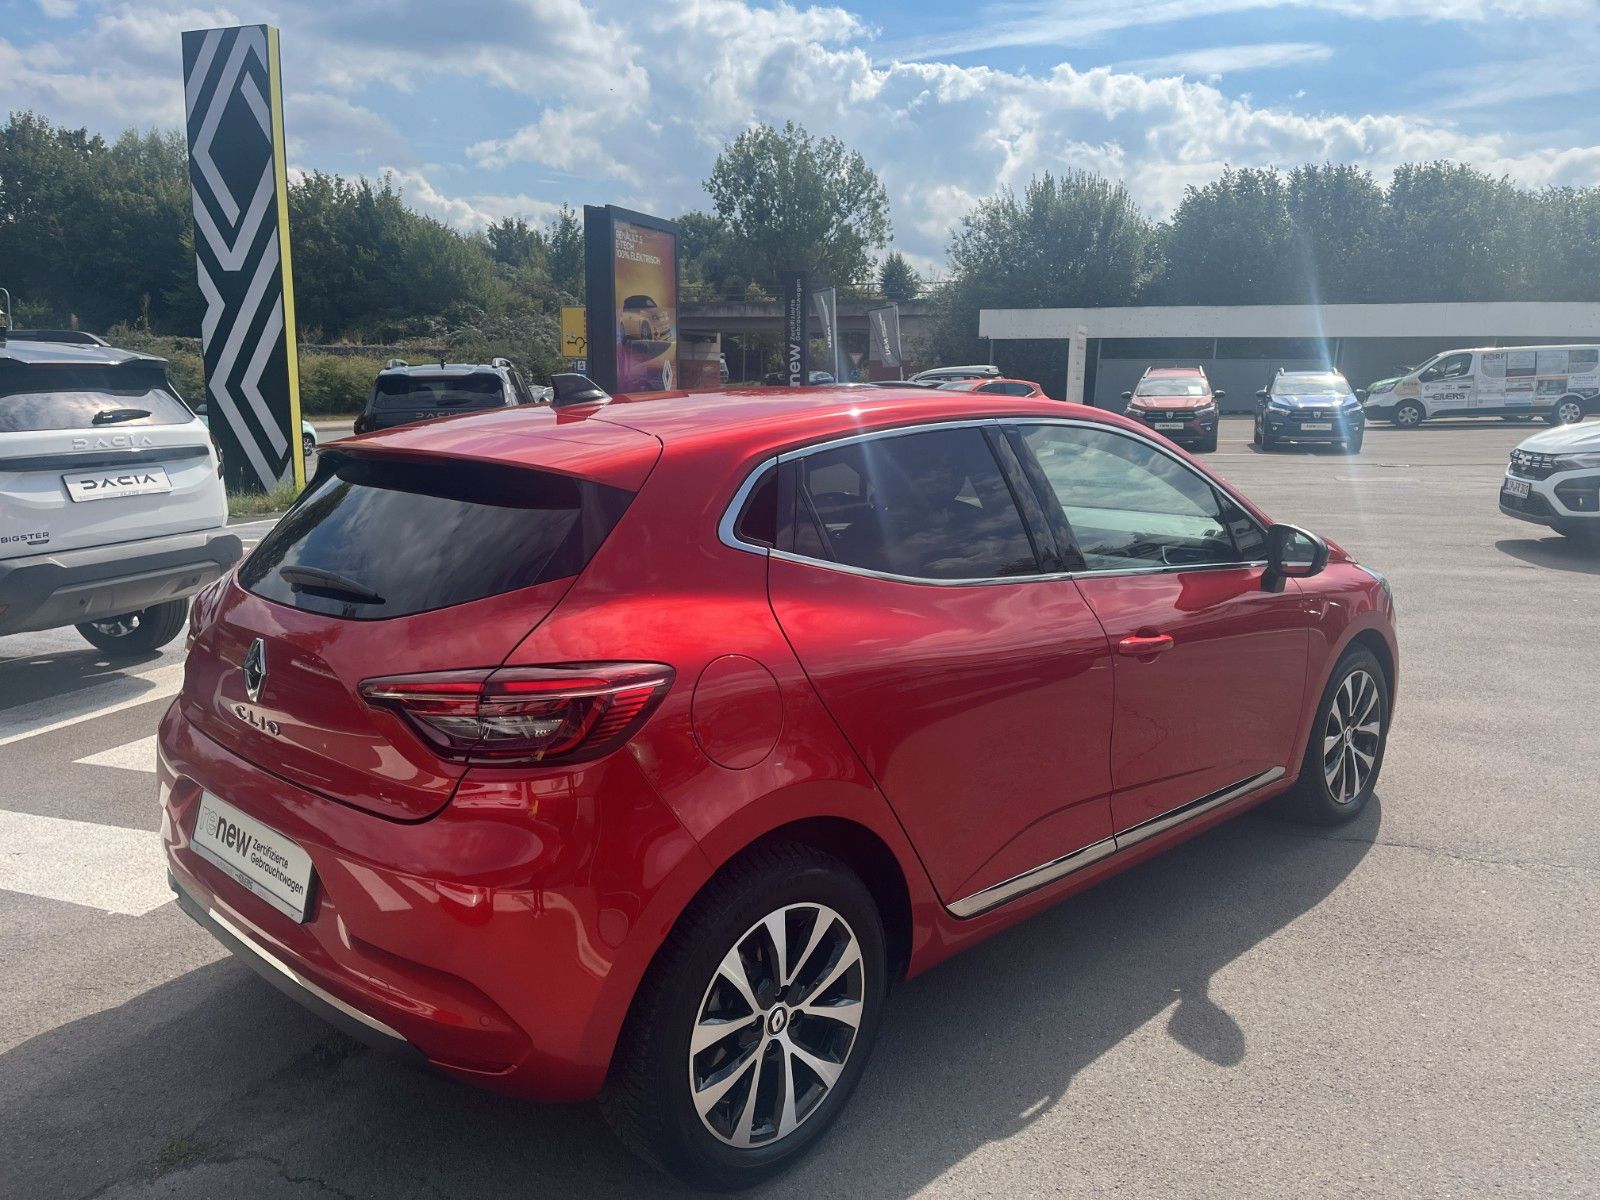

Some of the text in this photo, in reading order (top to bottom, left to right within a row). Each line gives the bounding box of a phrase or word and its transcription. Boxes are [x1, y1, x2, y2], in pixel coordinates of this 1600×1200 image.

[789, 344, 801, 387] new
[71, 435, 153, 450] DACIA
[79, 474, 158, 490] DACIA
[1, 531, 49, 543] BIGSTER
[235, 700, 281, 736] CLIO
[253, 838, 289, 870] Zertifizierte
[250, 852, 304, 896] Gebrauchtwagen
